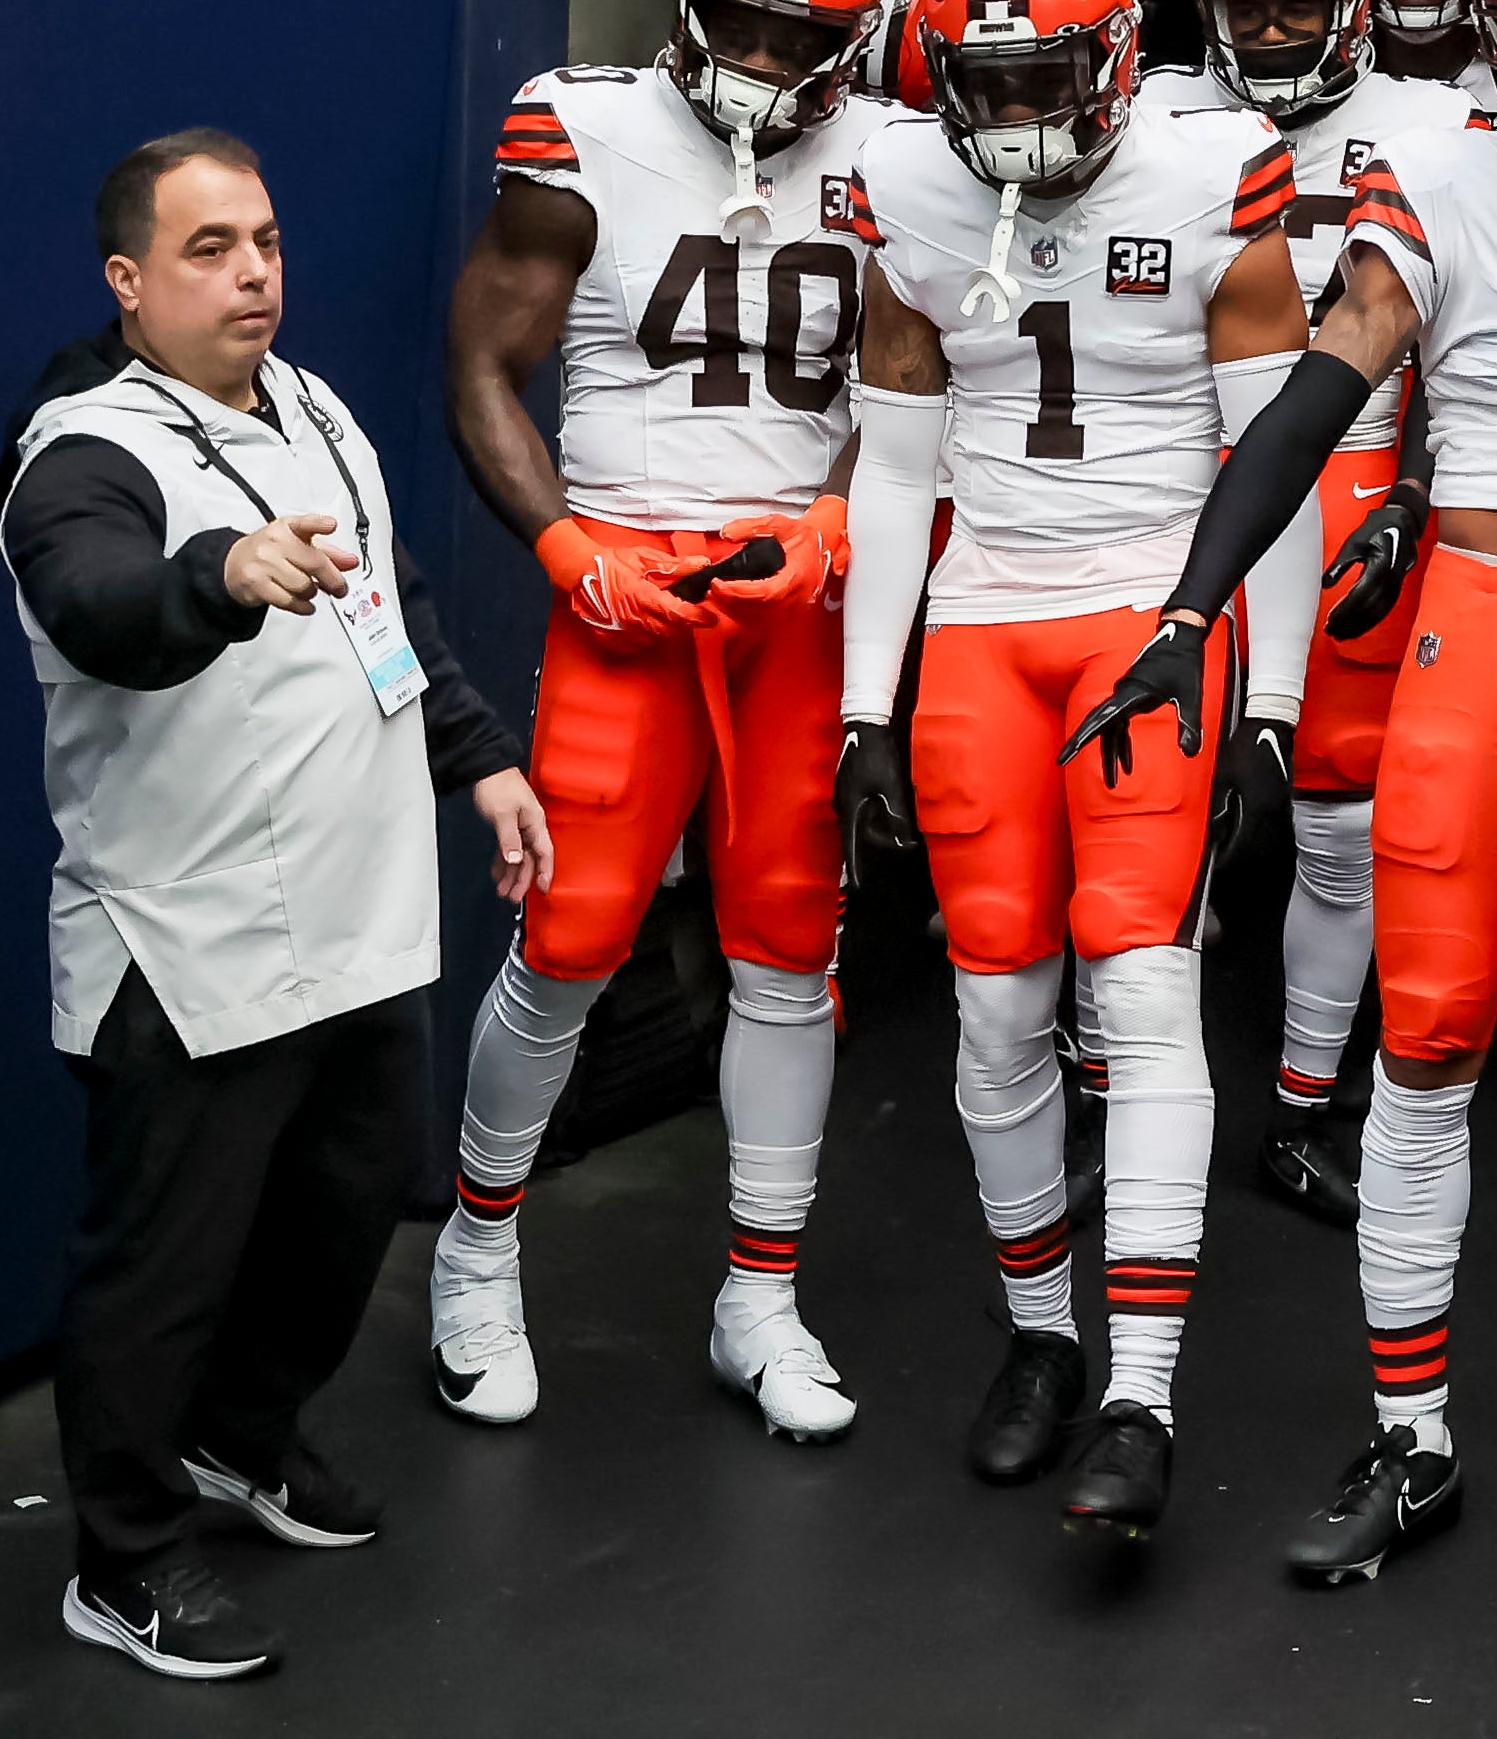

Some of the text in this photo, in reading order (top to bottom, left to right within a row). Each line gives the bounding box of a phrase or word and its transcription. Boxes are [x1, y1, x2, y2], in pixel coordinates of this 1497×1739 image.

[824, 180, 854, 221] 3
[1112, 241, 1167, 283] 32
[635, 233, 859, 415] 40
[1017, 299, 1086, 461] 1
